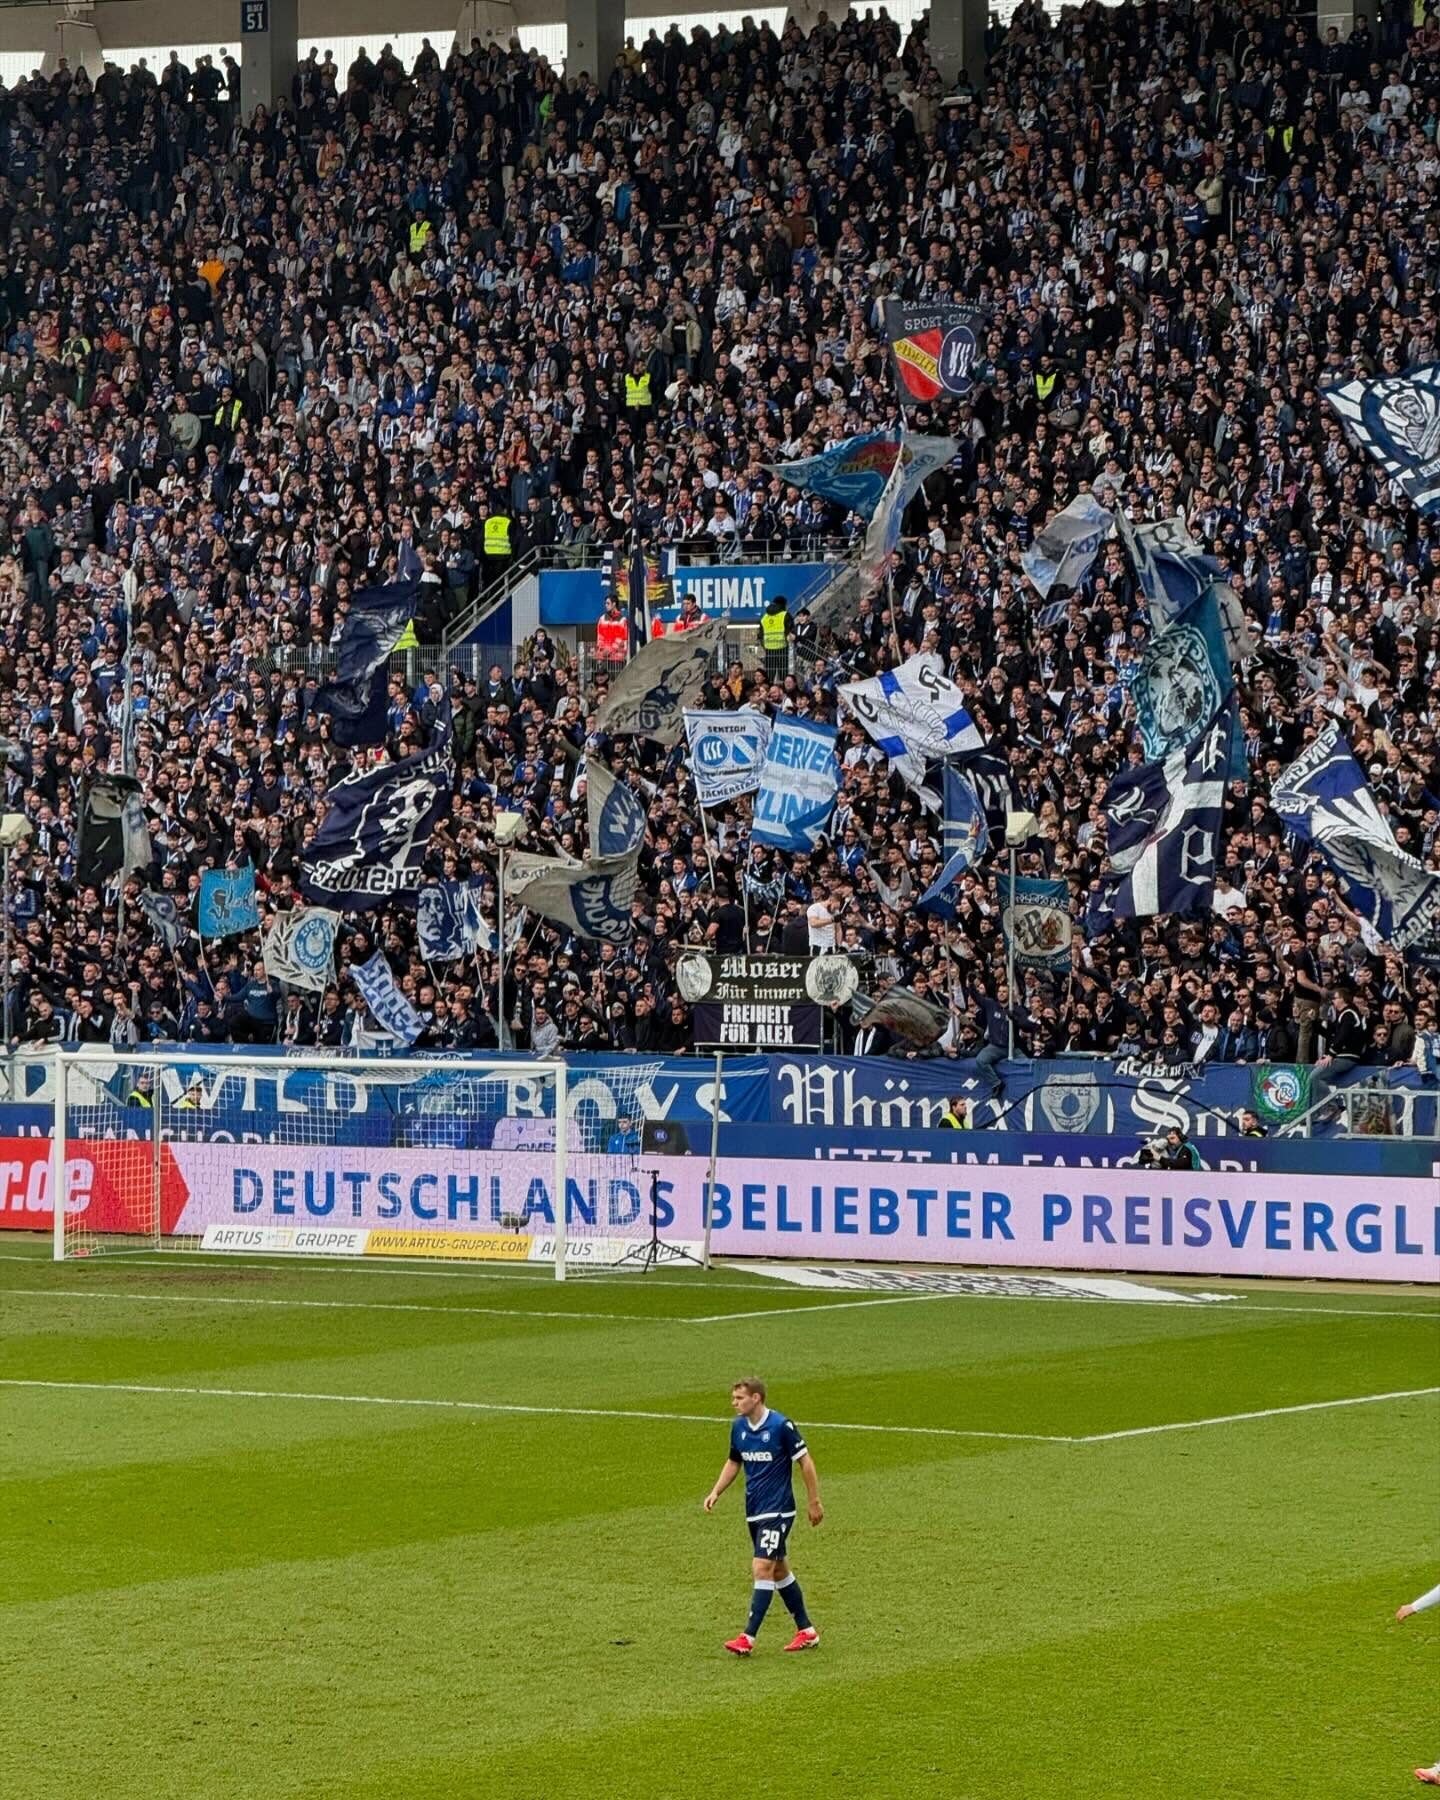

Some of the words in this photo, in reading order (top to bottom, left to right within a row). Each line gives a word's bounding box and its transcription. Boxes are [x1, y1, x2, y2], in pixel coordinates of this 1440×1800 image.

[247, 13, 263, 29] 51
[687, 577, 770, 609] HEIMAT.
[703, 741, 724, 762] KSC
[719, 955, 803, 979] Moser
[713, 982, 748, 1000] Für
[754, 984, 804, 1000] immer
[723, 1004, 792, 1024] FREIHEIT
[720, 1023, 749, 1042] FÜR
[756, 1024, 794, 1044] ALEX
[232, 1168, 675, 1228] DEUTSCHLANDS
[703, 1182, 1015, 1241] BELIEBTER
[213, 1230, 264, 1245] ARTUS
[295, 1232, 357, 1248] GRUPPE
[371, 1236, 528, 1252] WWW.ARTUS-GRUPPE.COM
[760, 1529, 780, 1549] 29
